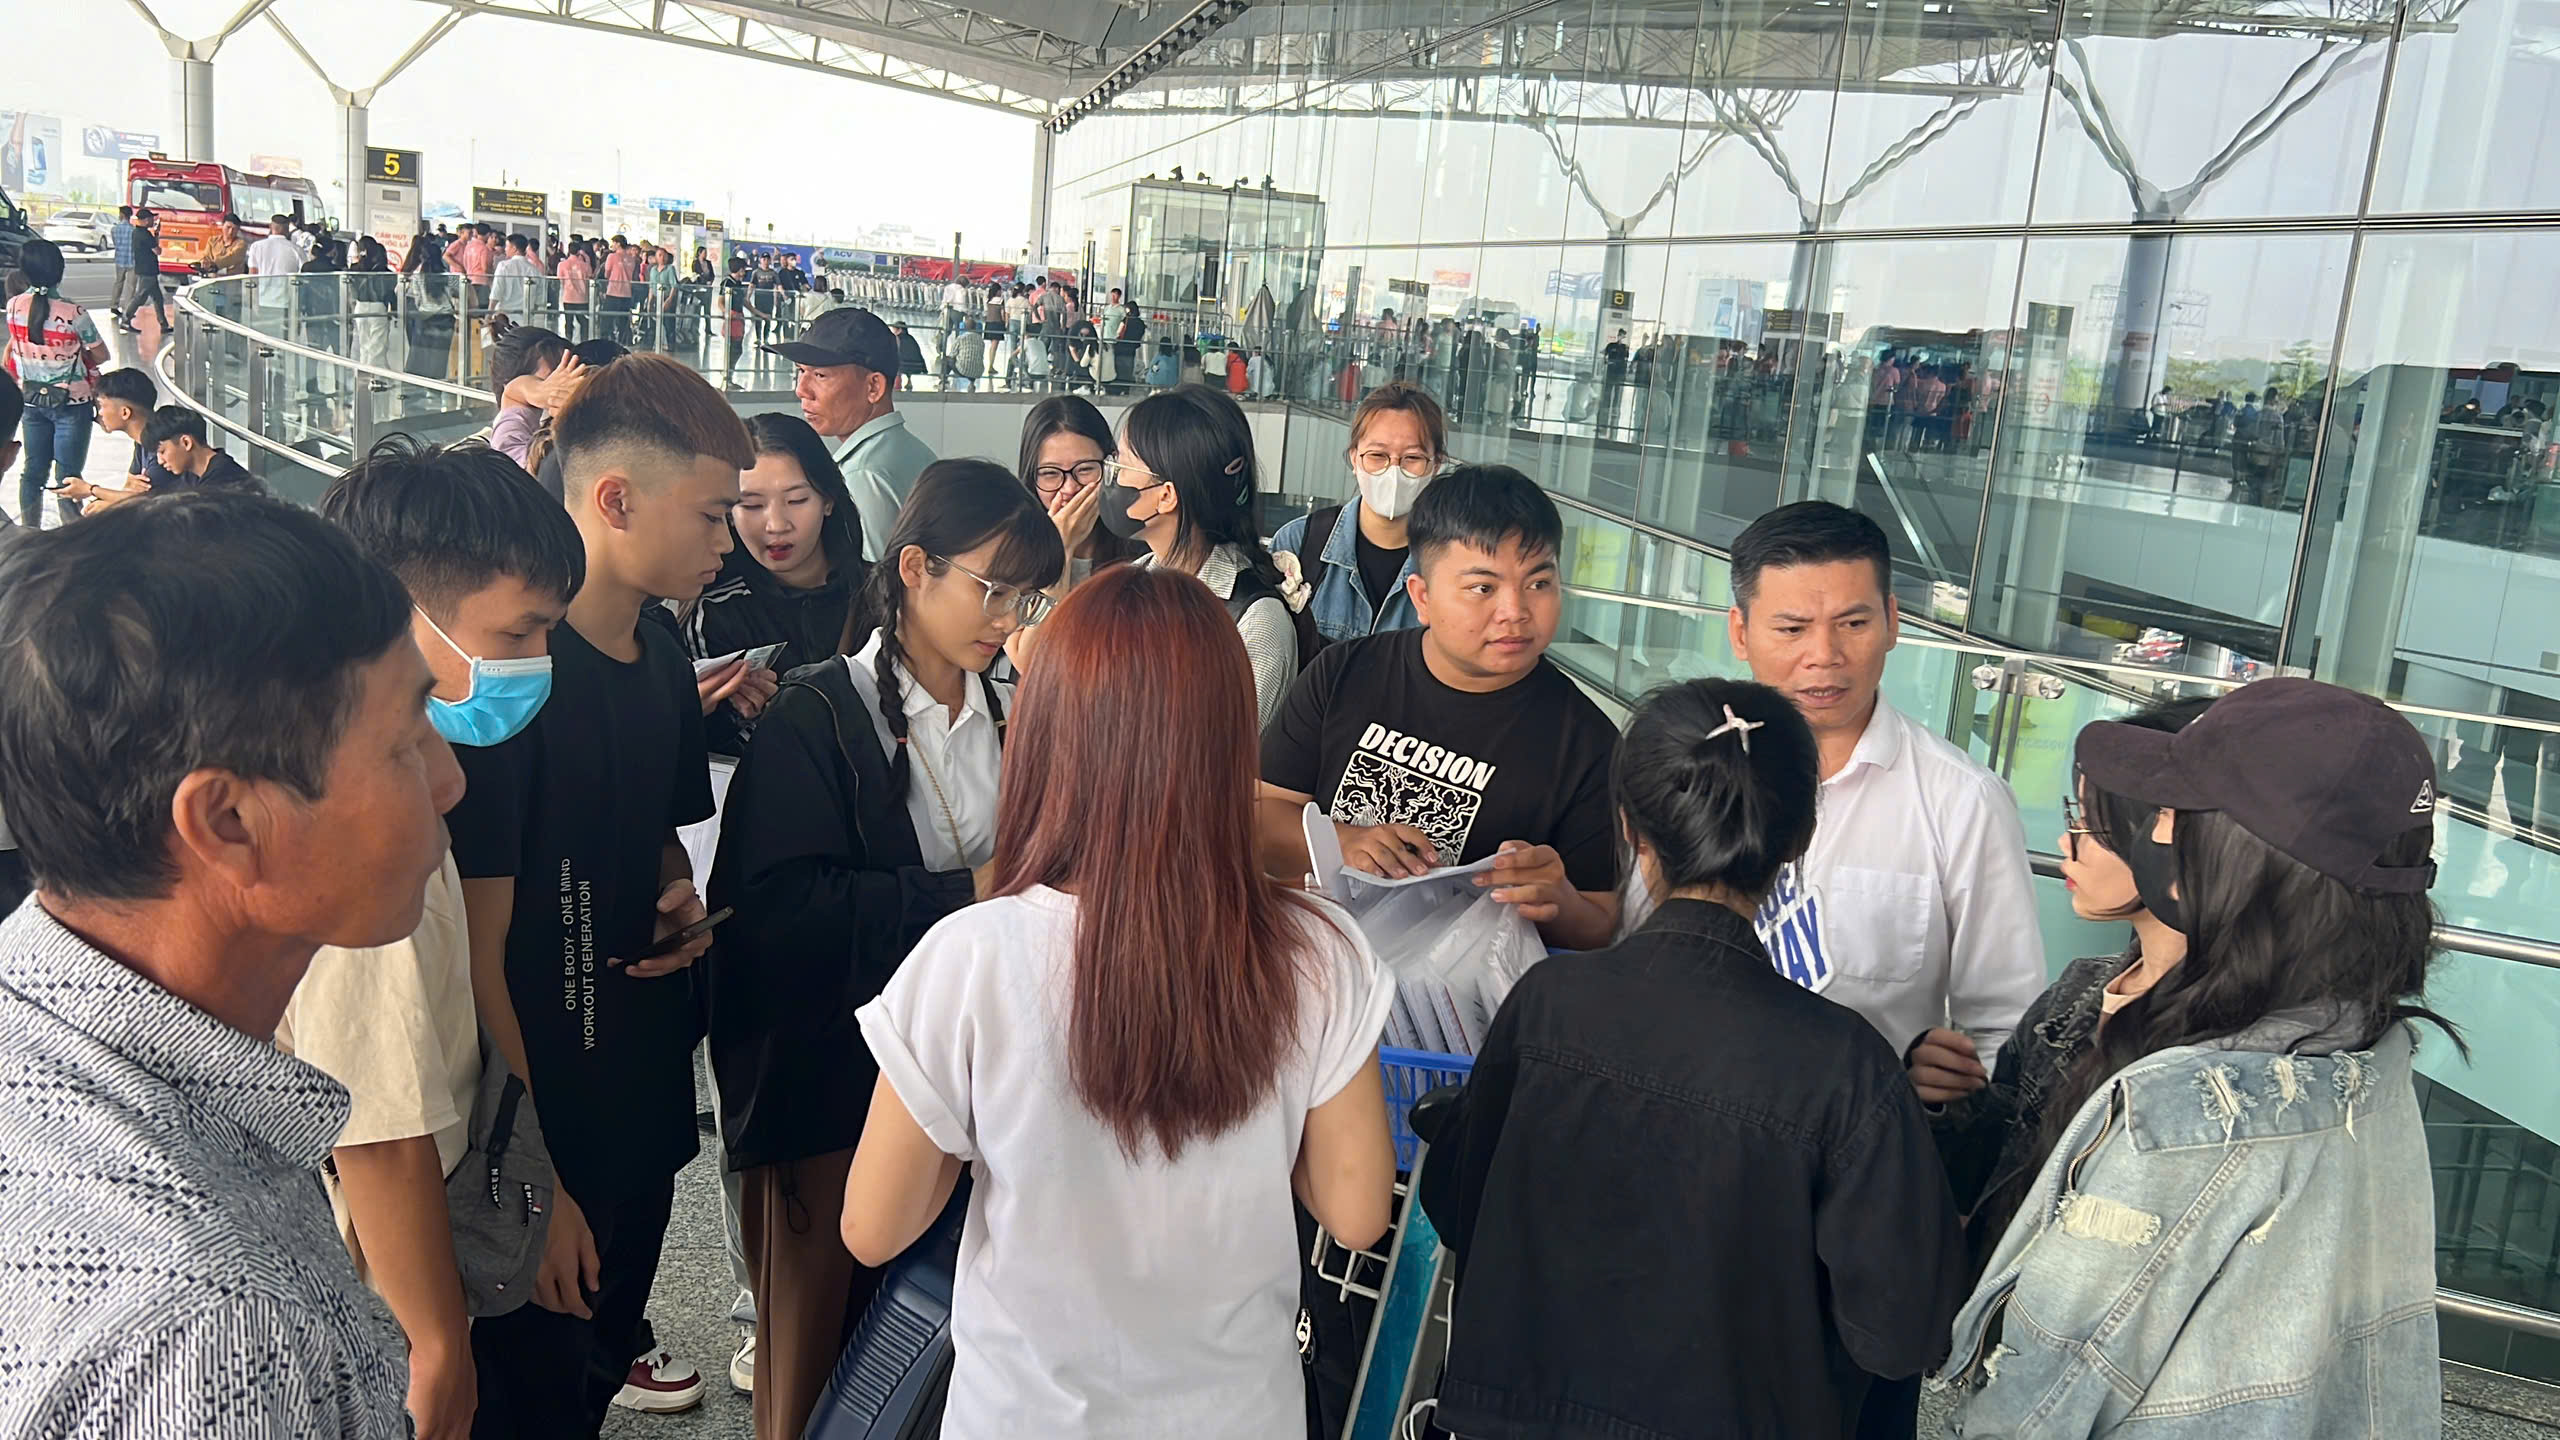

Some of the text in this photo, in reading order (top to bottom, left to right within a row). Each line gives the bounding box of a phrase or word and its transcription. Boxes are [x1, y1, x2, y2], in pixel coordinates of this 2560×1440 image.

[384, 152, 400, 175] 5
[582, 194, 592, 208] 6
[666, 211, 675, 222] 7
[834, 250, 853, 258] ACV
[1357, 722, 1497, 791] DECISION
[560, 858, 571, 892] MIND
[561, 895, 574, 925] ONE
[564, 936, 576, 975] BODY
[578, 880, 595, 1050] WORKOUT GENERATION
[565, 979, 576, 1011] ONE
